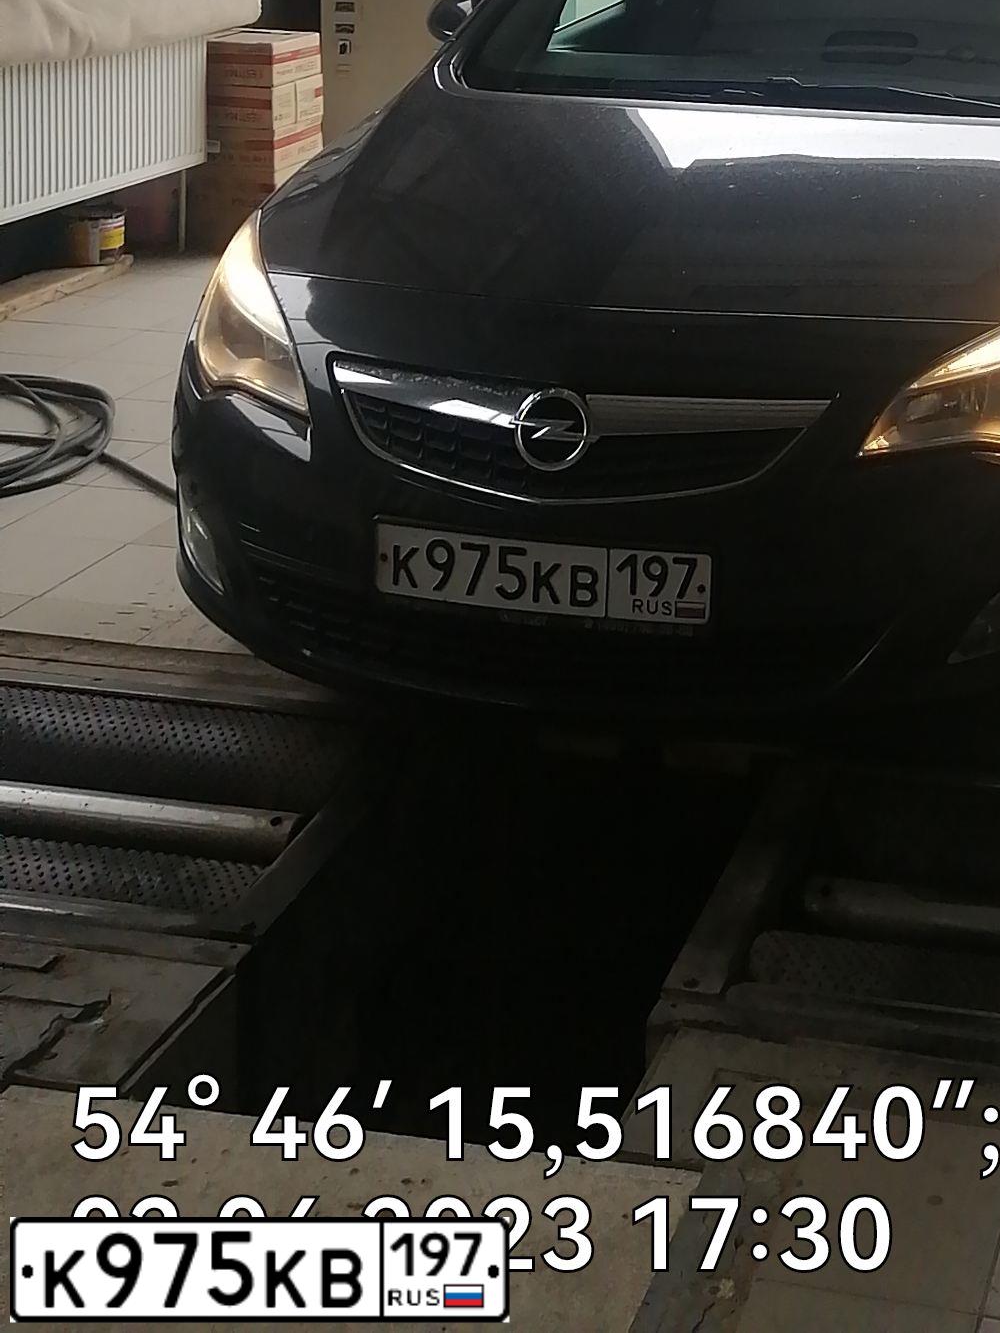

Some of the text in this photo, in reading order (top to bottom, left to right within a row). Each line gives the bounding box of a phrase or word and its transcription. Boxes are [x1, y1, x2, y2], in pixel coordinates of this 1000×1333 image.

[391, 538, 699, 608] К975КВ 197
[631, 598, 673, 616] RUS
